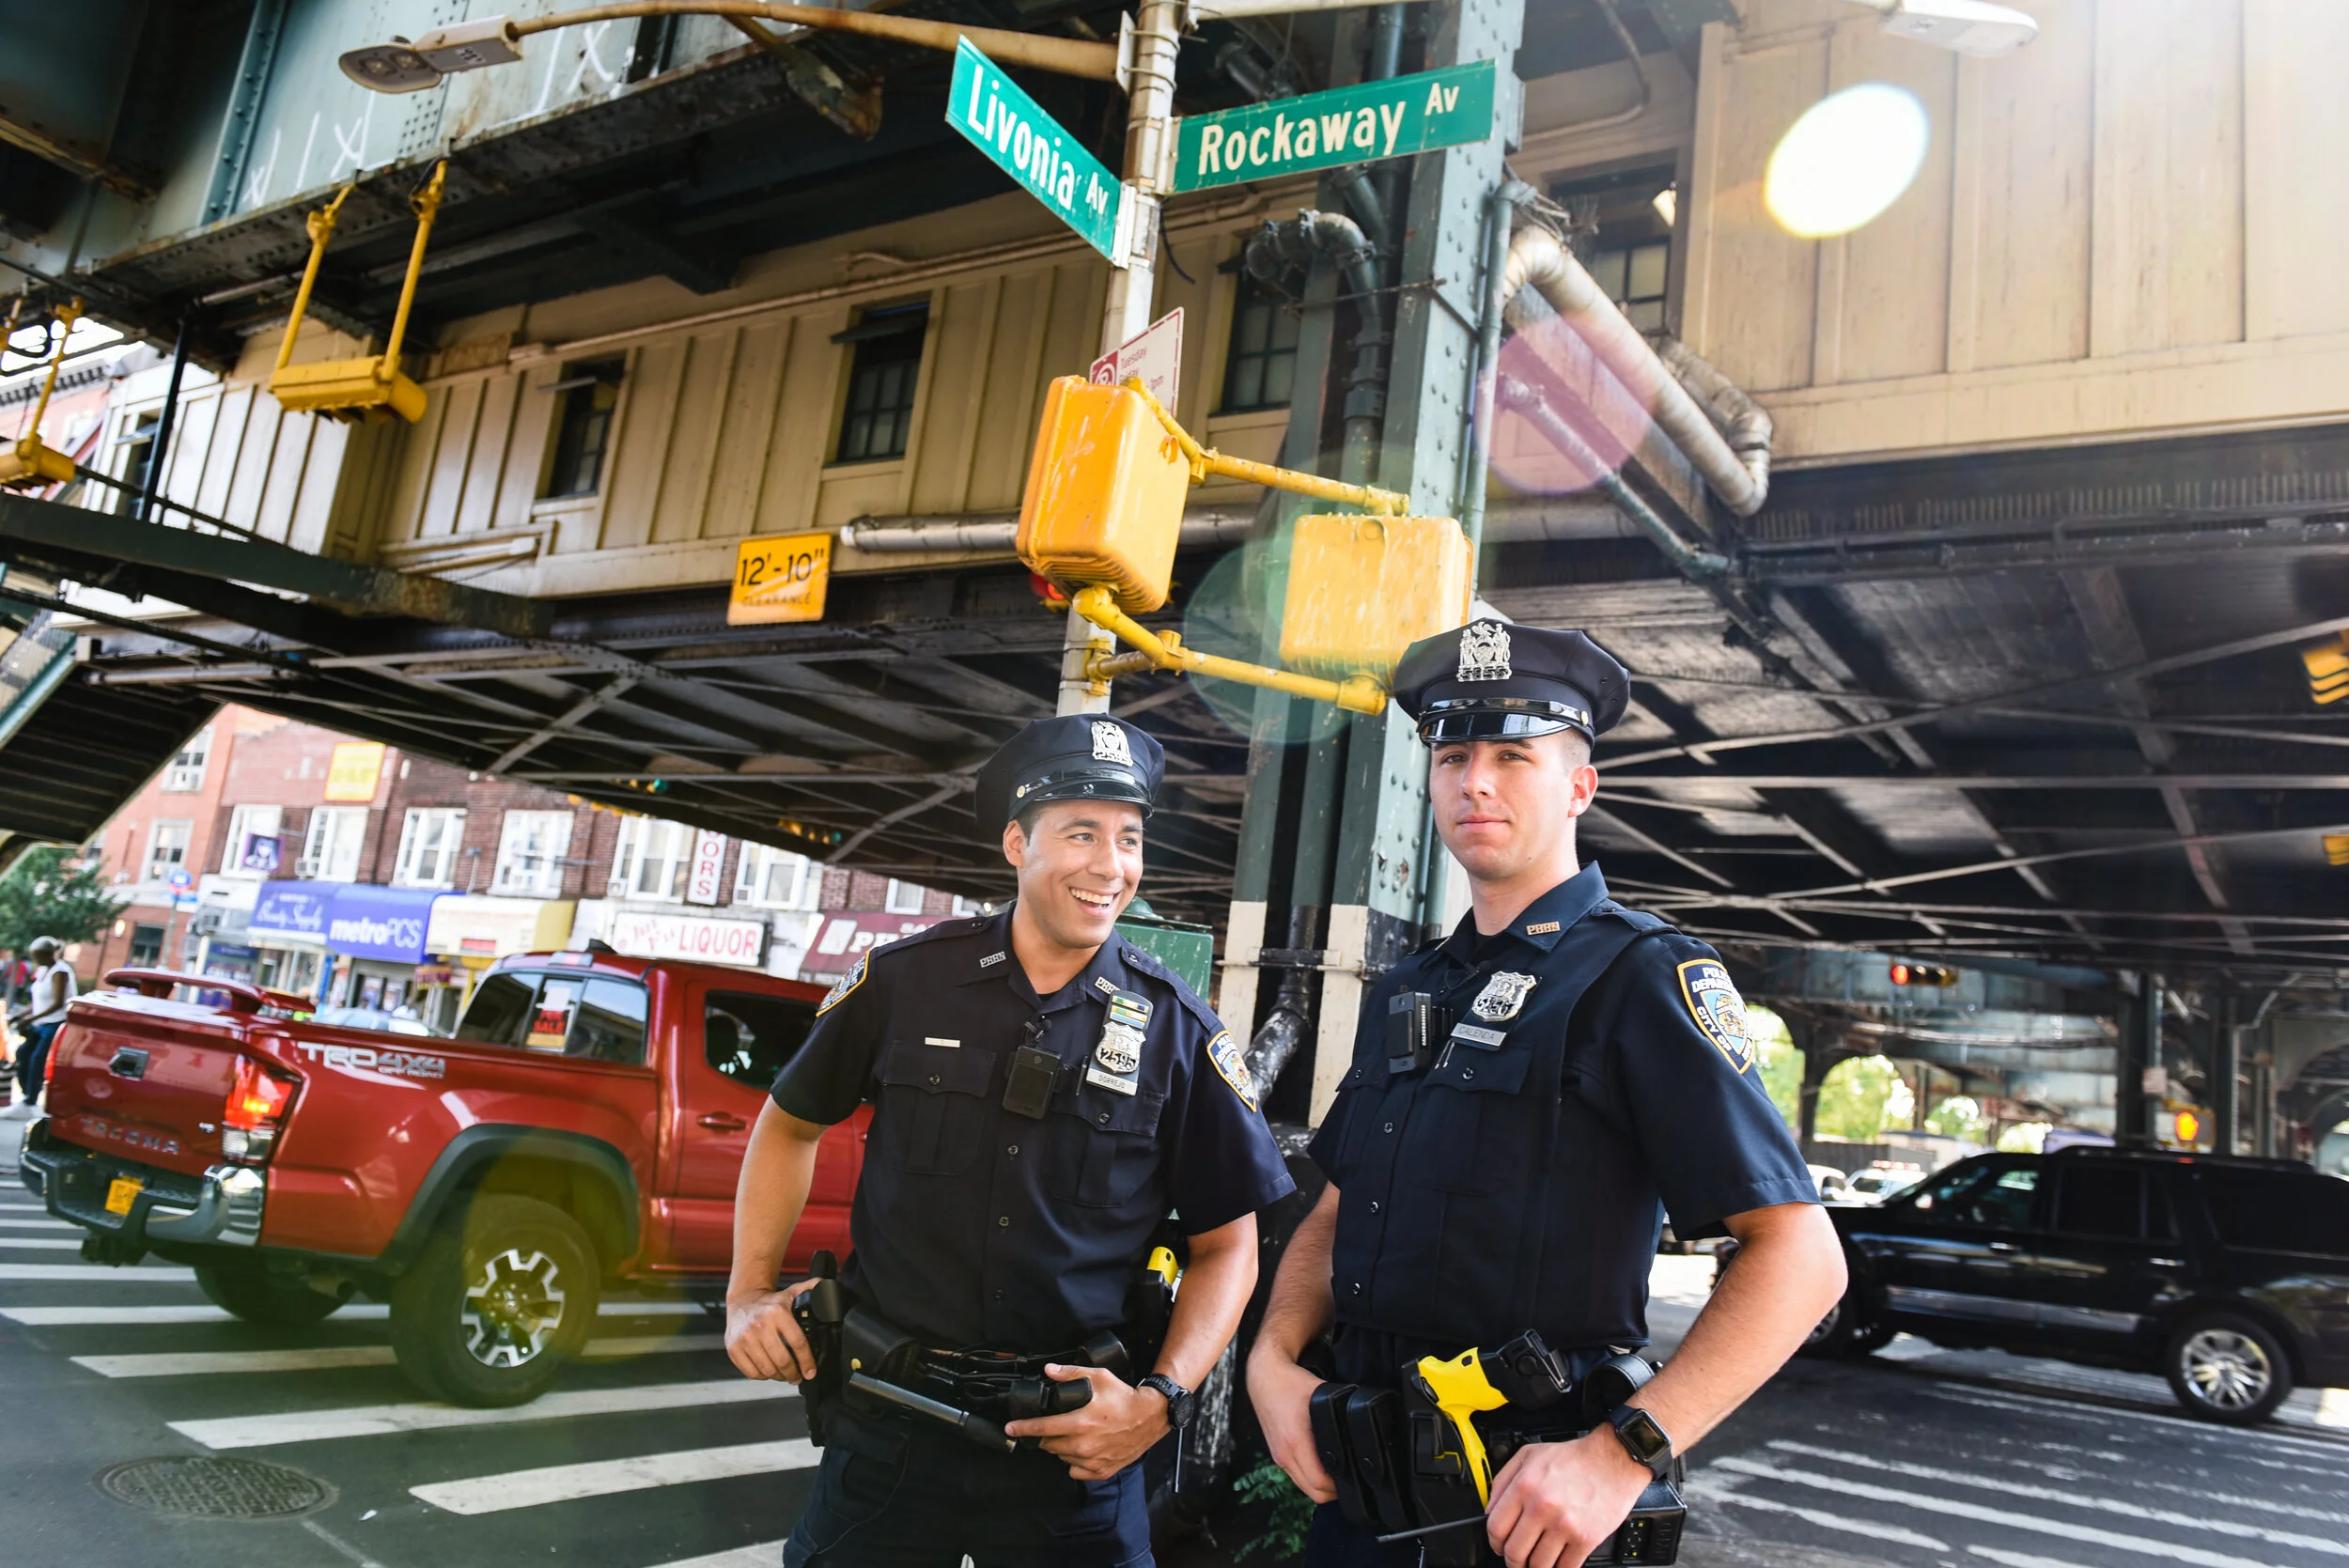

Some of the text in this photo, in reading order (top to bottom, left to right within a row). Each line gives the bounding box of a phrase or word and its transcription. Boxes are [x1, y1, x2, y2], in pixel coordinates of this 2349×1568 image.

[966, 63, 1109, 215] Livonia Av
[1198, 83, 1459, 176] Rockaway Av
[1120, 348, 1147, 369] Tuesday
[742, 592, 813, 606] CLEARANCE
[330, 917, 423, 948] metroPCS
[678, 924, 757, 957] LIQUOR
[1697, 1006, 1732, 1051] CITY OF
[297, 1041, 376, 1070] TRD
[1100, 1048, 1136, 1070] 2595
[81, 1118, 179, 1155] TACOMA
